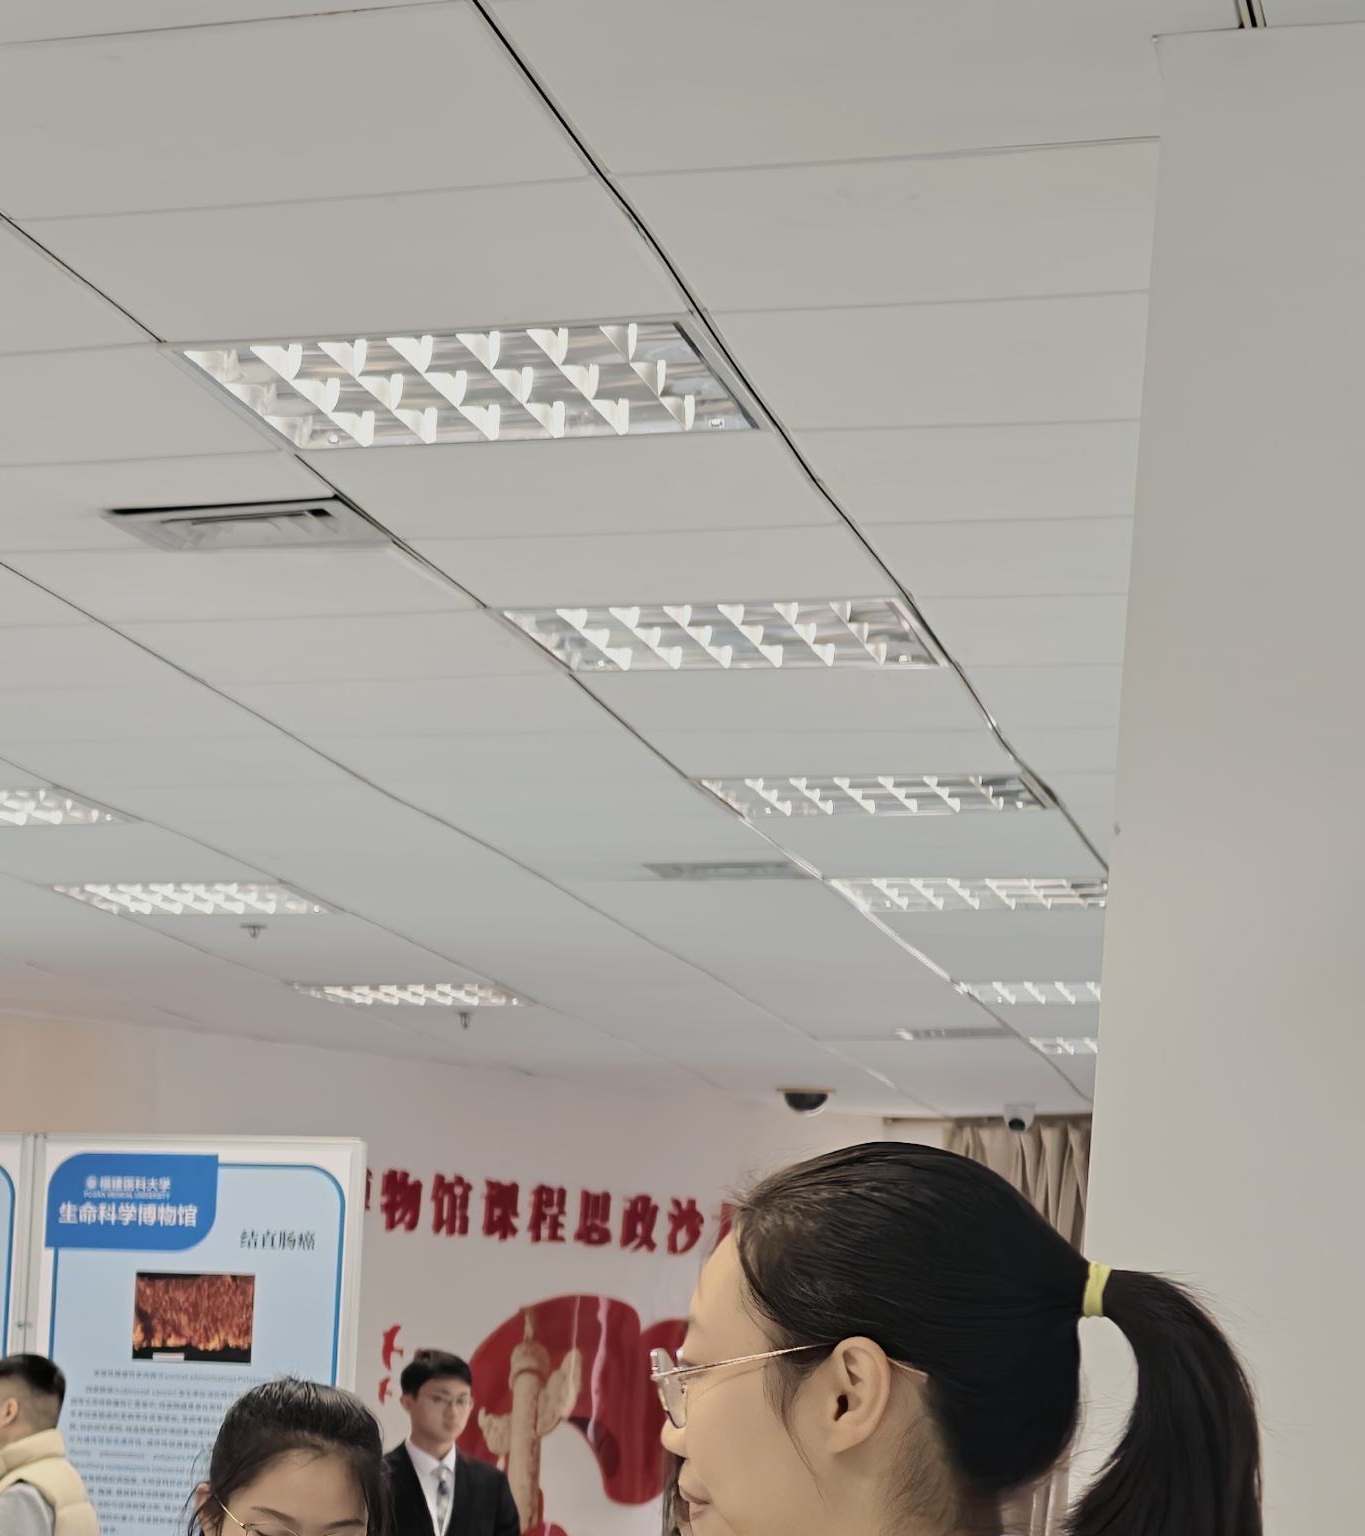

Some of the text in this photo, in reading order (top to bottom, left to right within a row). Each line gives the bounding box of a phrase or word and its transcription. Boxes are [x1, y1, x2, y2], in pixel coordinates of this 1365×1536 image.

[100, 1176, 171, 1192] 福建医科大学
[58, 1201, 198, 1227] 生命科学博物馆
[366, 1168, 736, 1256] 物馆课程思政沙
[240, 1228, 316, 1251] 结直肠癌
